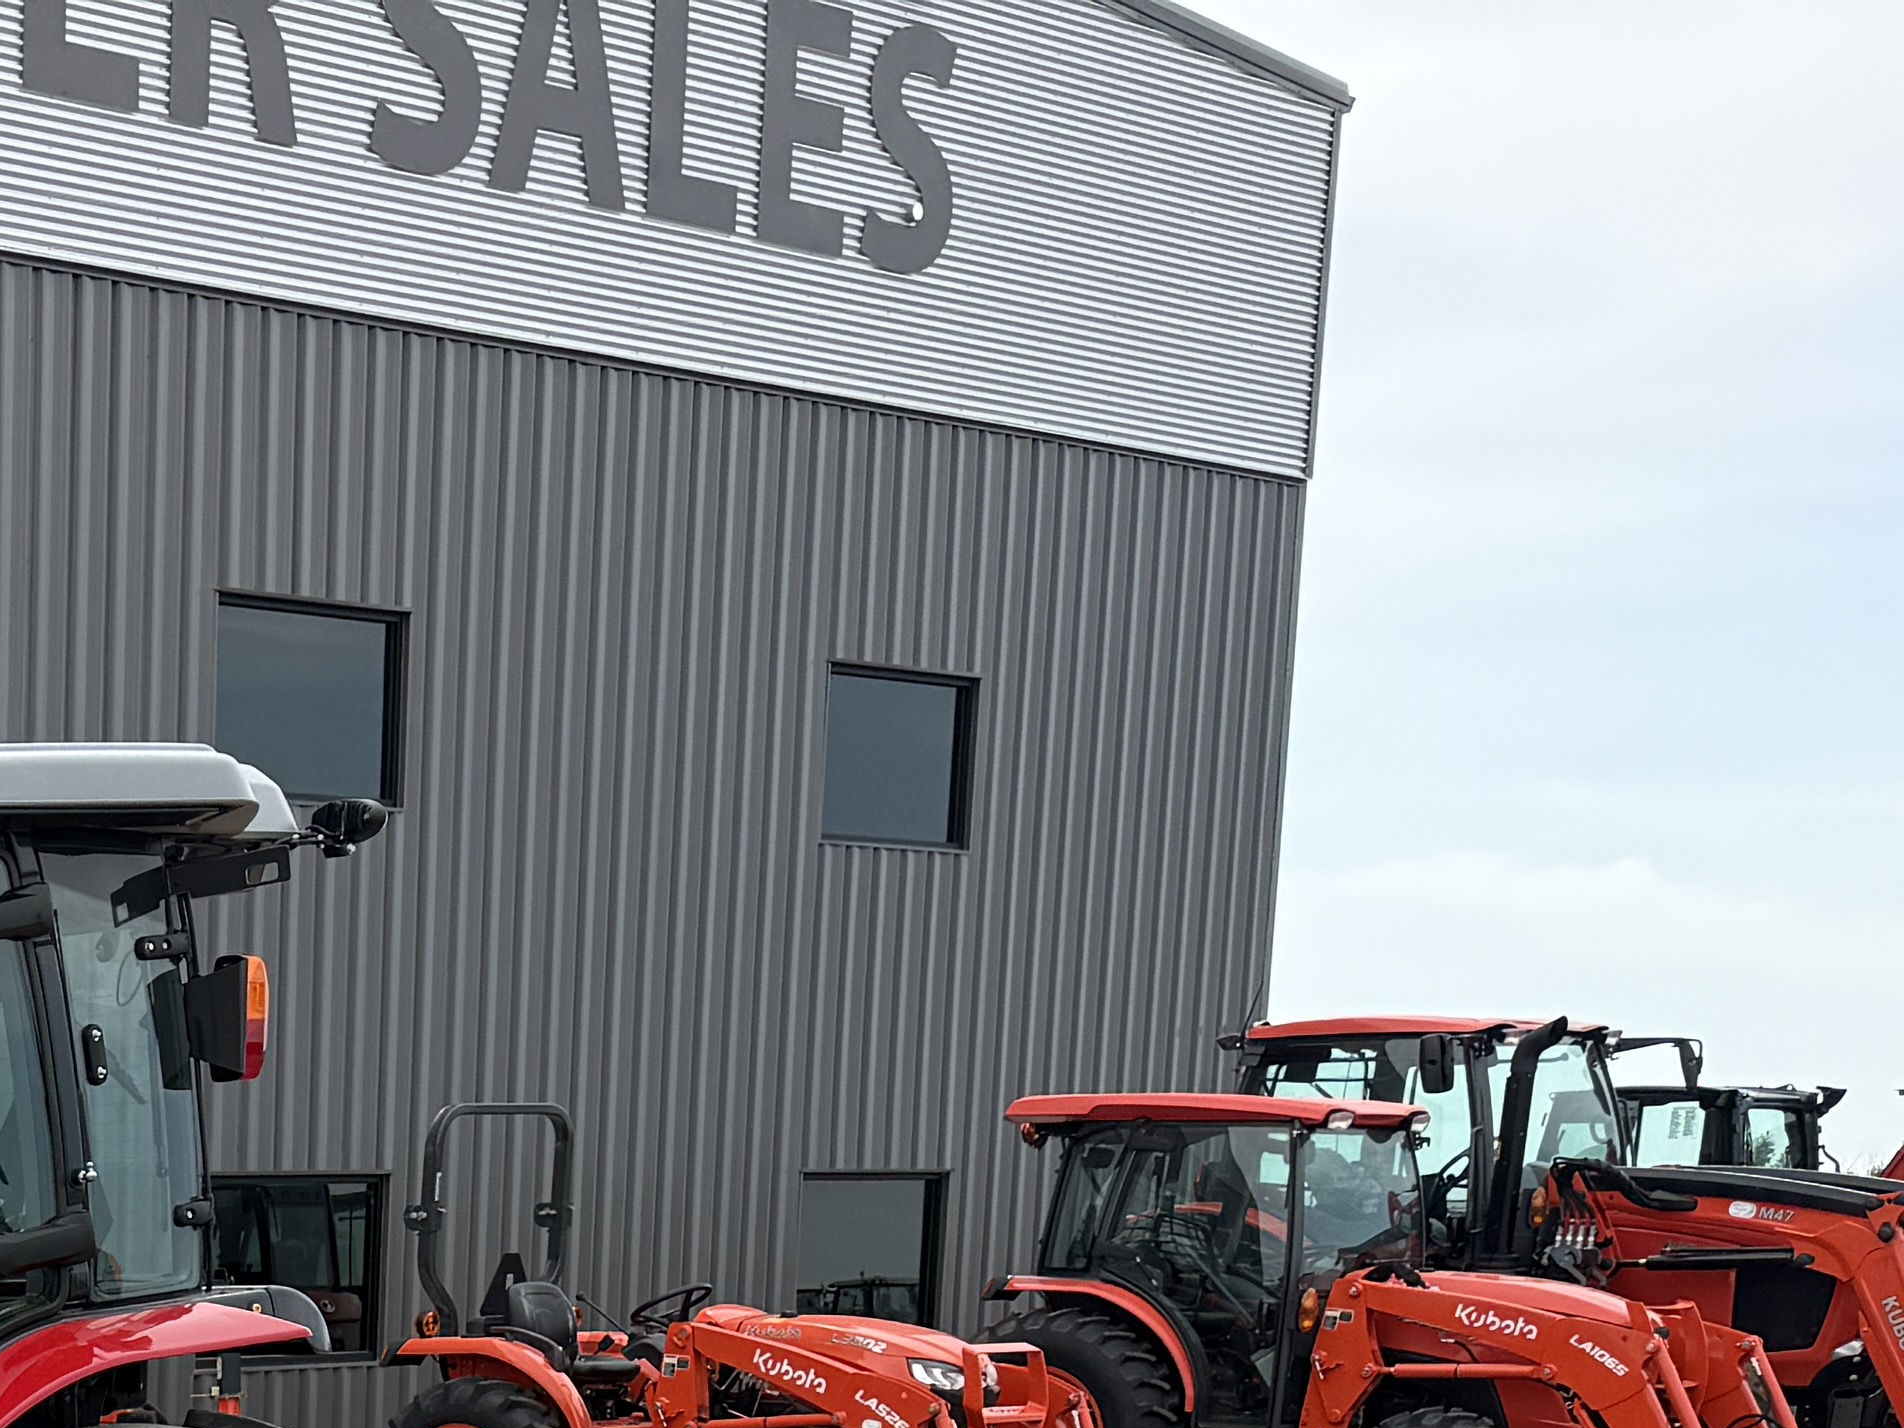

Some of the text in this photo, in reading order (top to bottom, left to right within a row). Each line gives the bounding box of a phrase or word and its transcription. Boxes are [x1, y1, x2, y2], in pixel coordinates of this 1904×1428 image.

[366, 0, 958, 274] SALES
[1758, 1207, 1795, 1223] M47
[1454, 1303, 1538, 1340] Kubota
[753, 1348, 827, 1394] Kubota
[1569, 1334, 1629, 1377] LA1065
